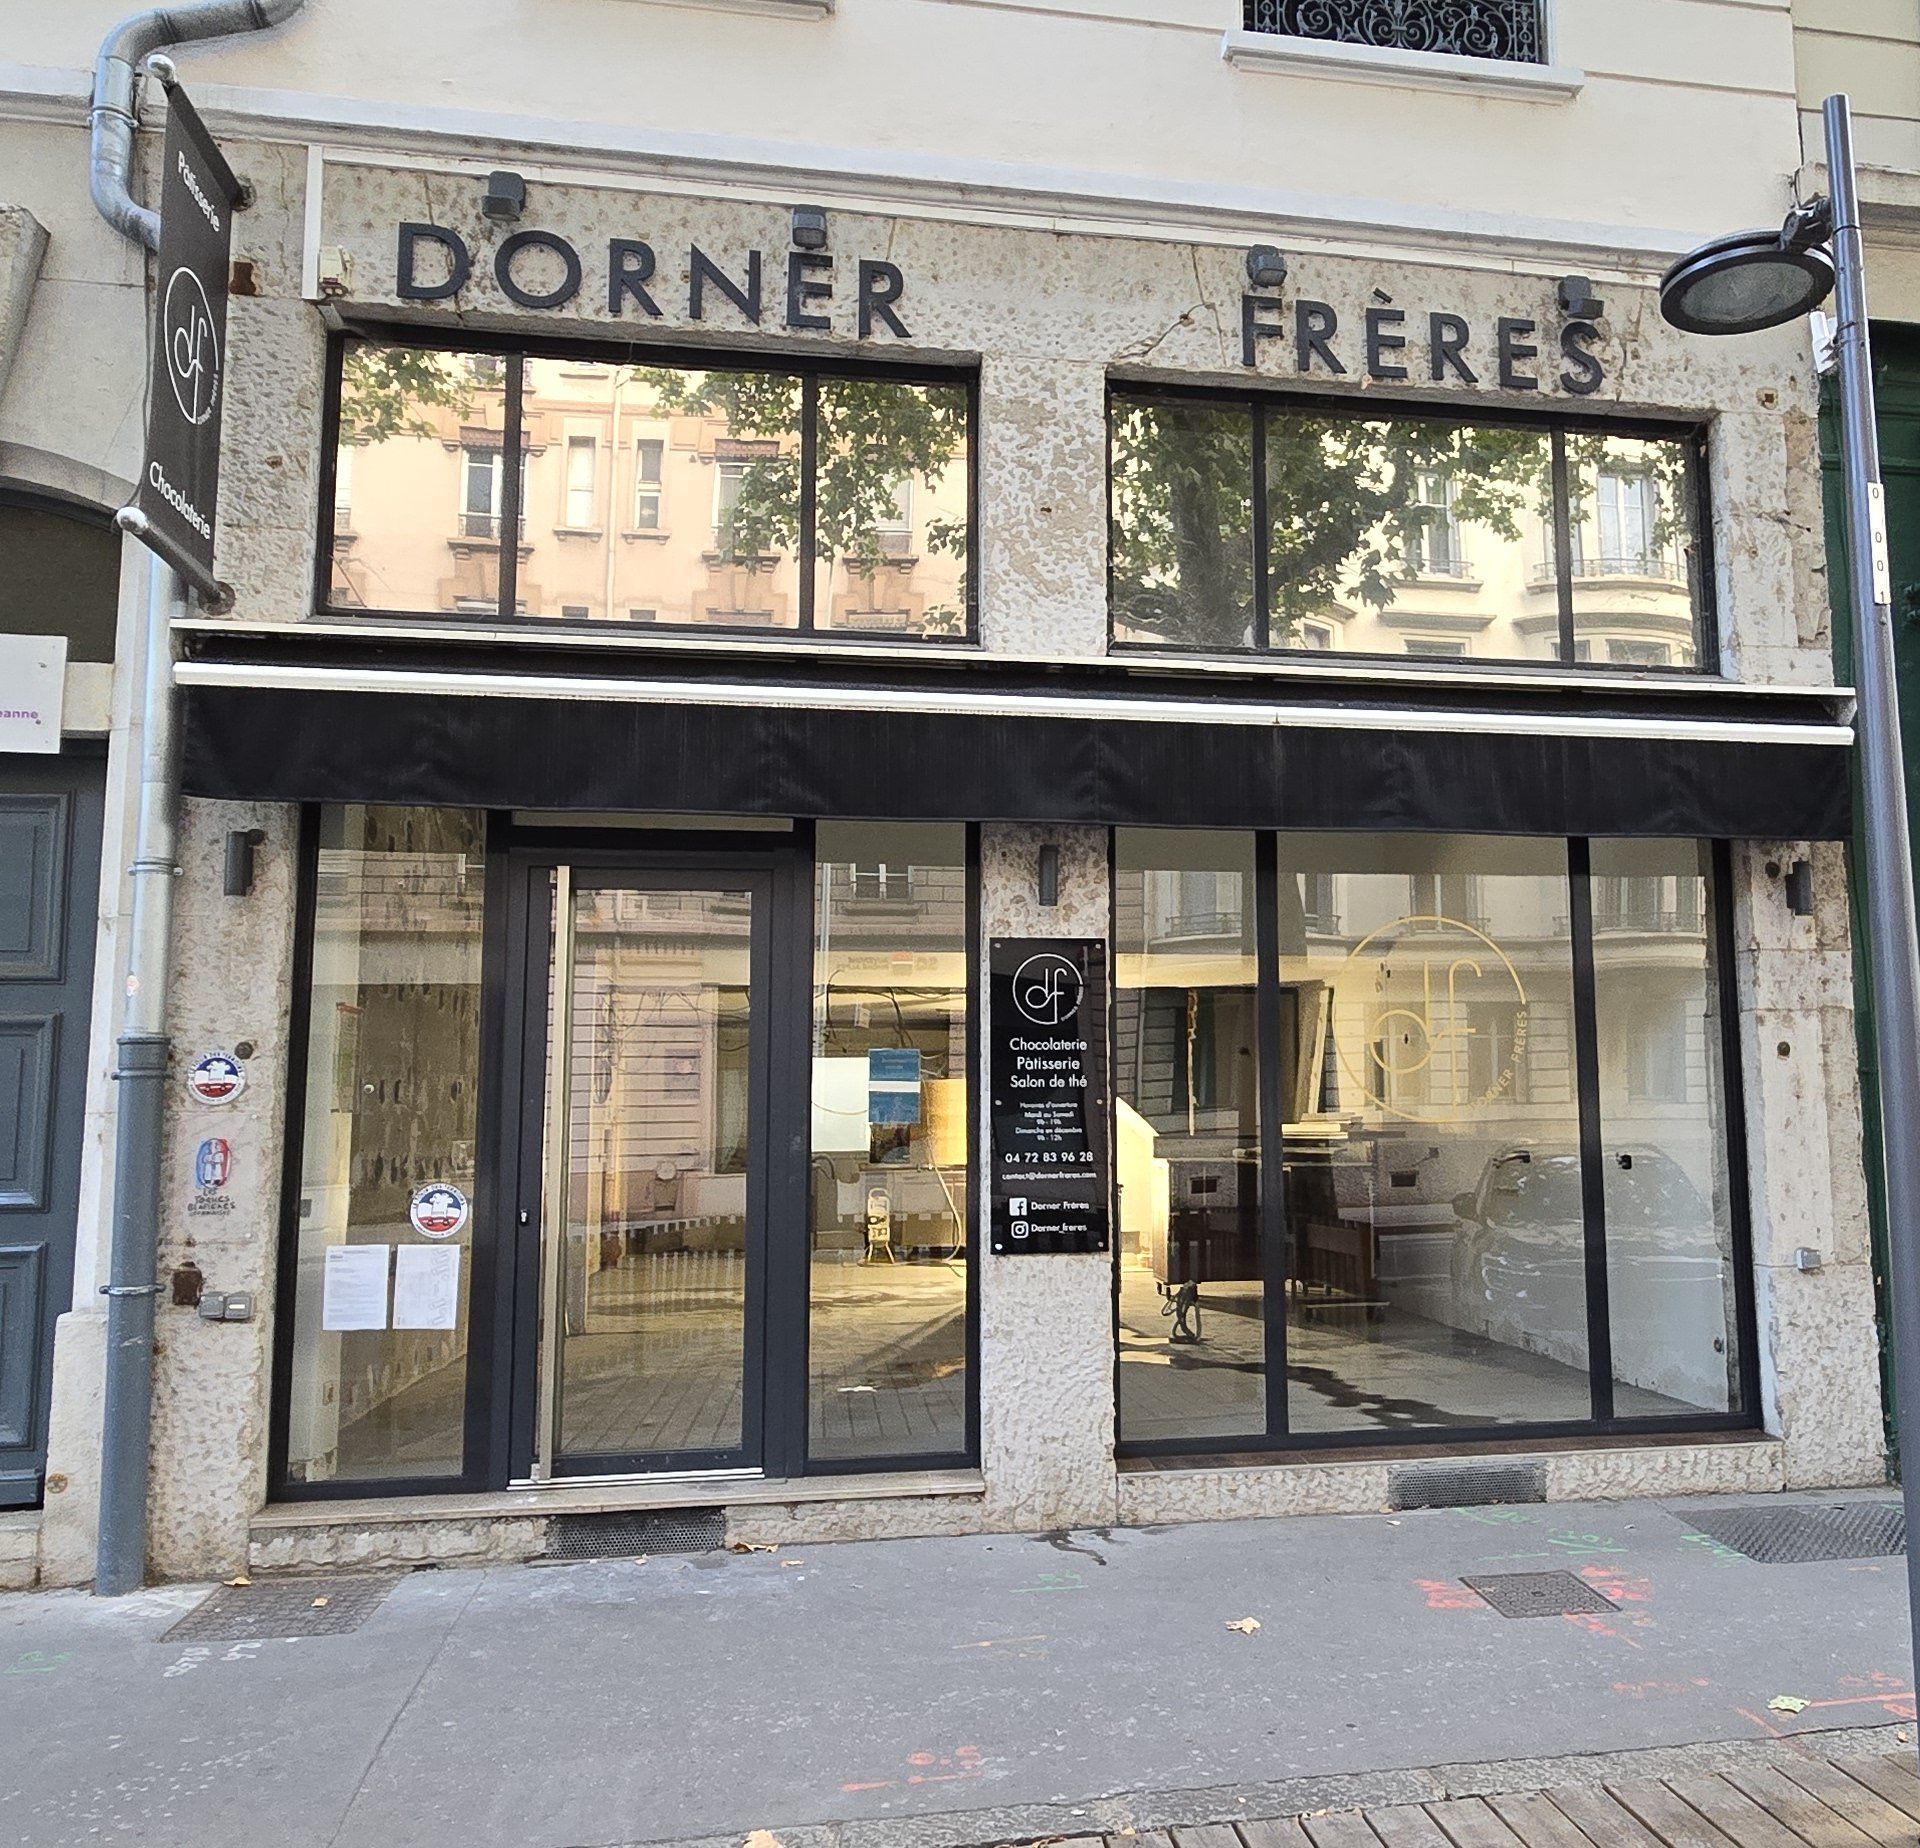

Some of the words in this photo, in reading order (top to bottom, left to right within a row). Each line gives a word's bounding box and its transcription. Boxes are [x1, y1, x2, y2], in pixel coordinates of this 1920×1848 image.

[396, 221, 912, 339] DORNER
[1242, 287, 1604, 395] FRÈRES
[150, 461, 211, 540] Chocolaterie
[0, 709, 39, 720] anne
[1009, 1036, 1088, 1051] Chocolaterie
[1017, 1056, 1081, 1070] Pâtisserie
[1009, 1074, 1046, 1088] Salon
[1049, 1073, 1066, 1088] de
[1068, 1073, 1088, 1088] thé
[1005, 1153, 1020, 1163] 04
[1024, 1152, 1039, 1163] 72
[1043, 1152, 1058, 1162] 83
[1061, 1151, 1076, 1162] 96
[1079, 1151, 1094, 1162] 28
[1031, 1201, 1061, 1210] Dorner
